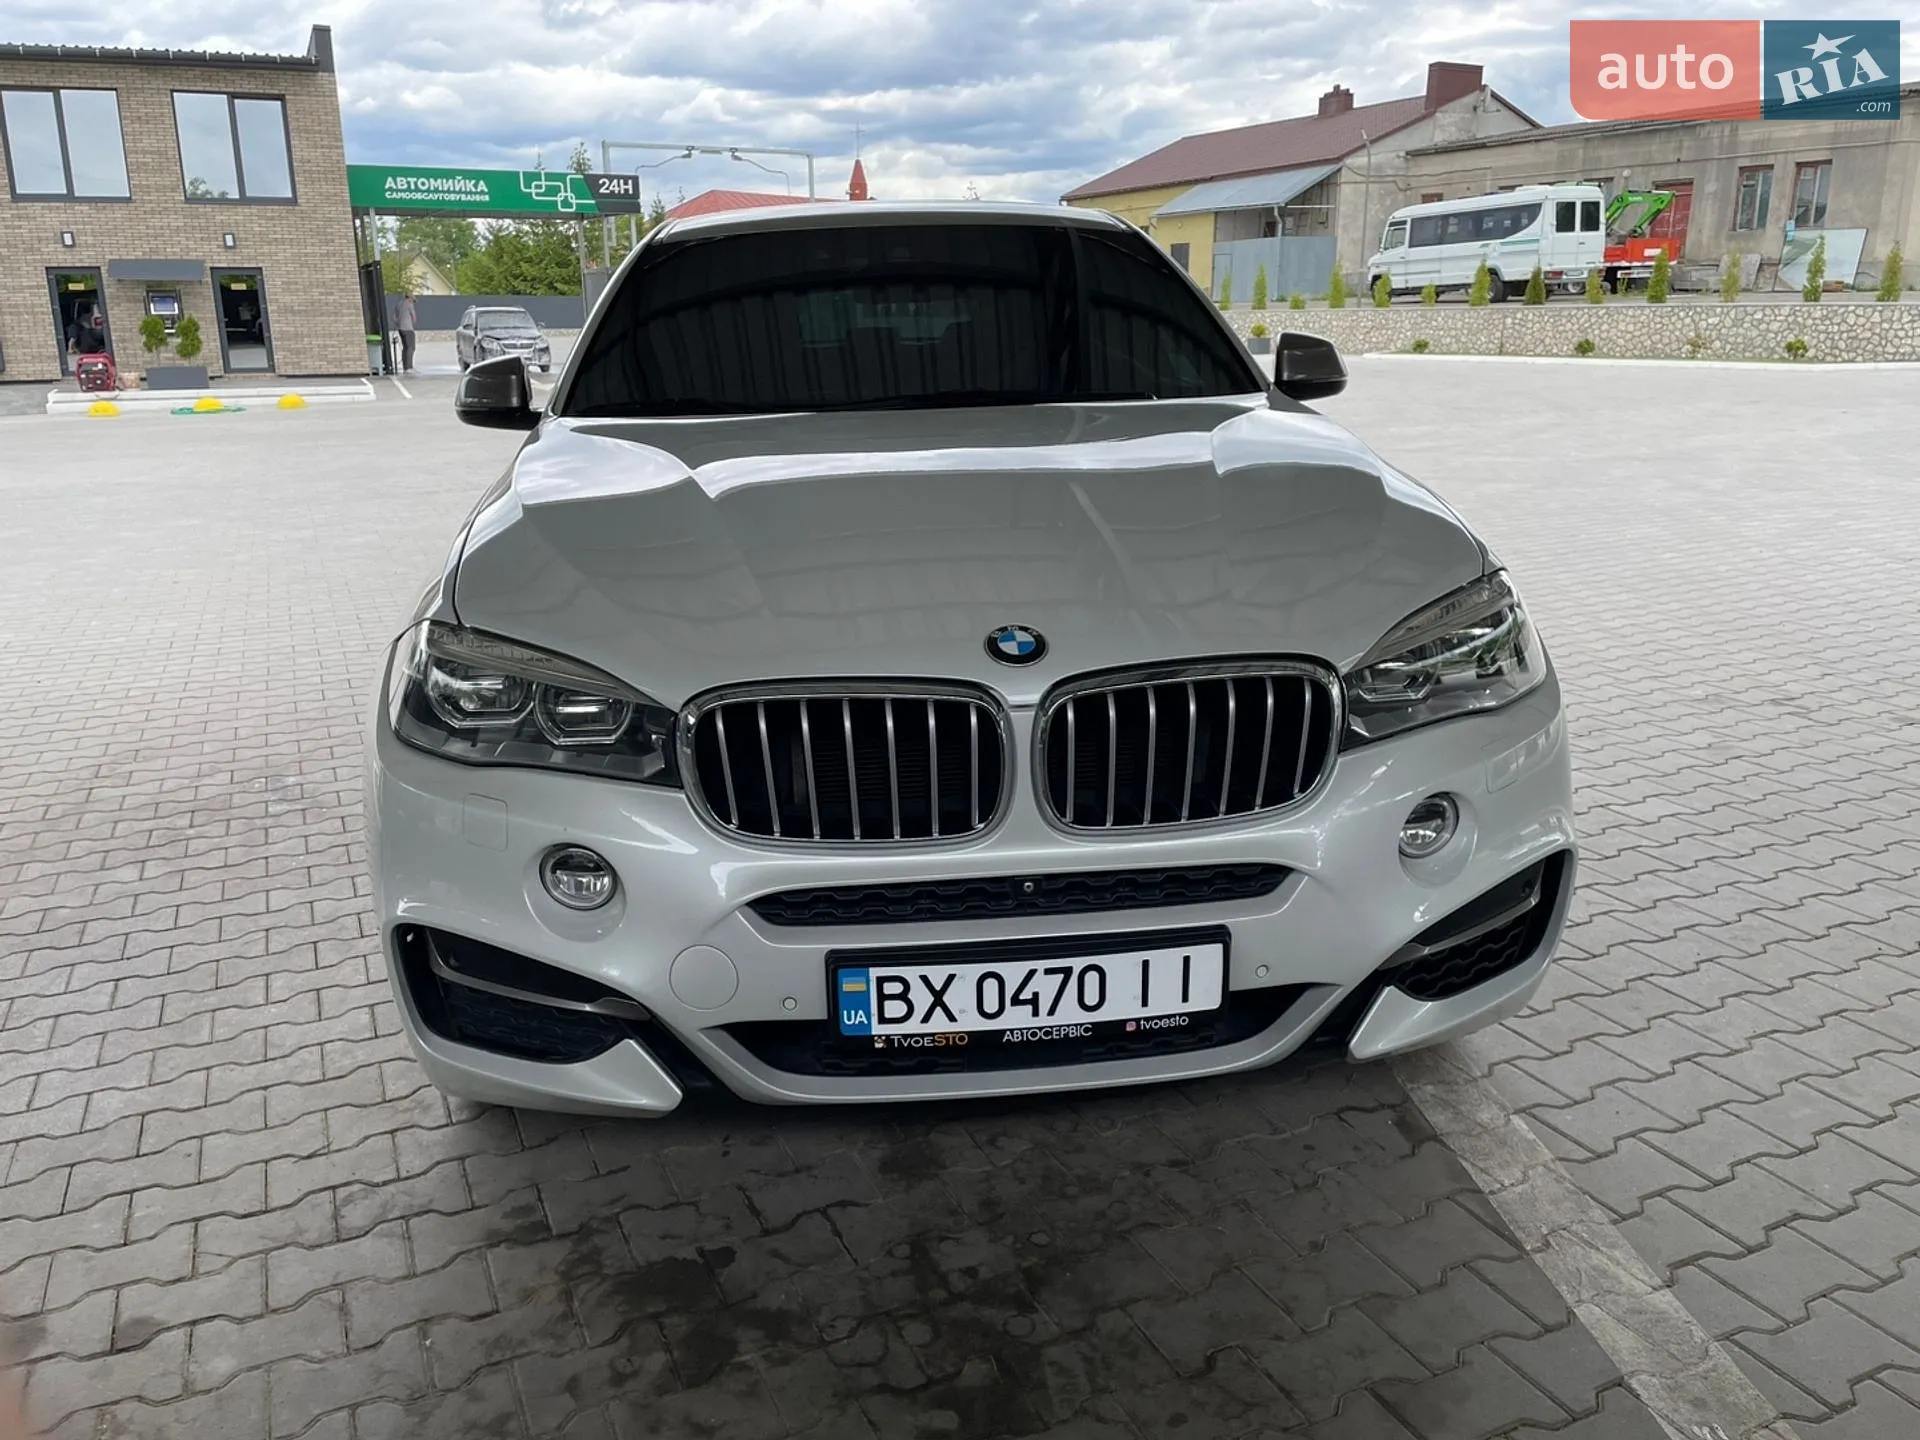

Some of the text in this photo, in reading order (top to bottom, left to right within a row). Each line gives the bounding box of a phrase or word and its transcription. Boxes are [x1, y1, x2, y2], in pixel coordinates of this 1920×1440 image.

[384, 176, 488, 192] АВТОМИЙКА
[976, 963, 1107, 1020] 0470
[843, 1009, 868, 1025] UA
[1140, 1015, 1189, 1030] tvoesto
[1002, 1024, 1093, 1043] АВТОСЕРВІС
